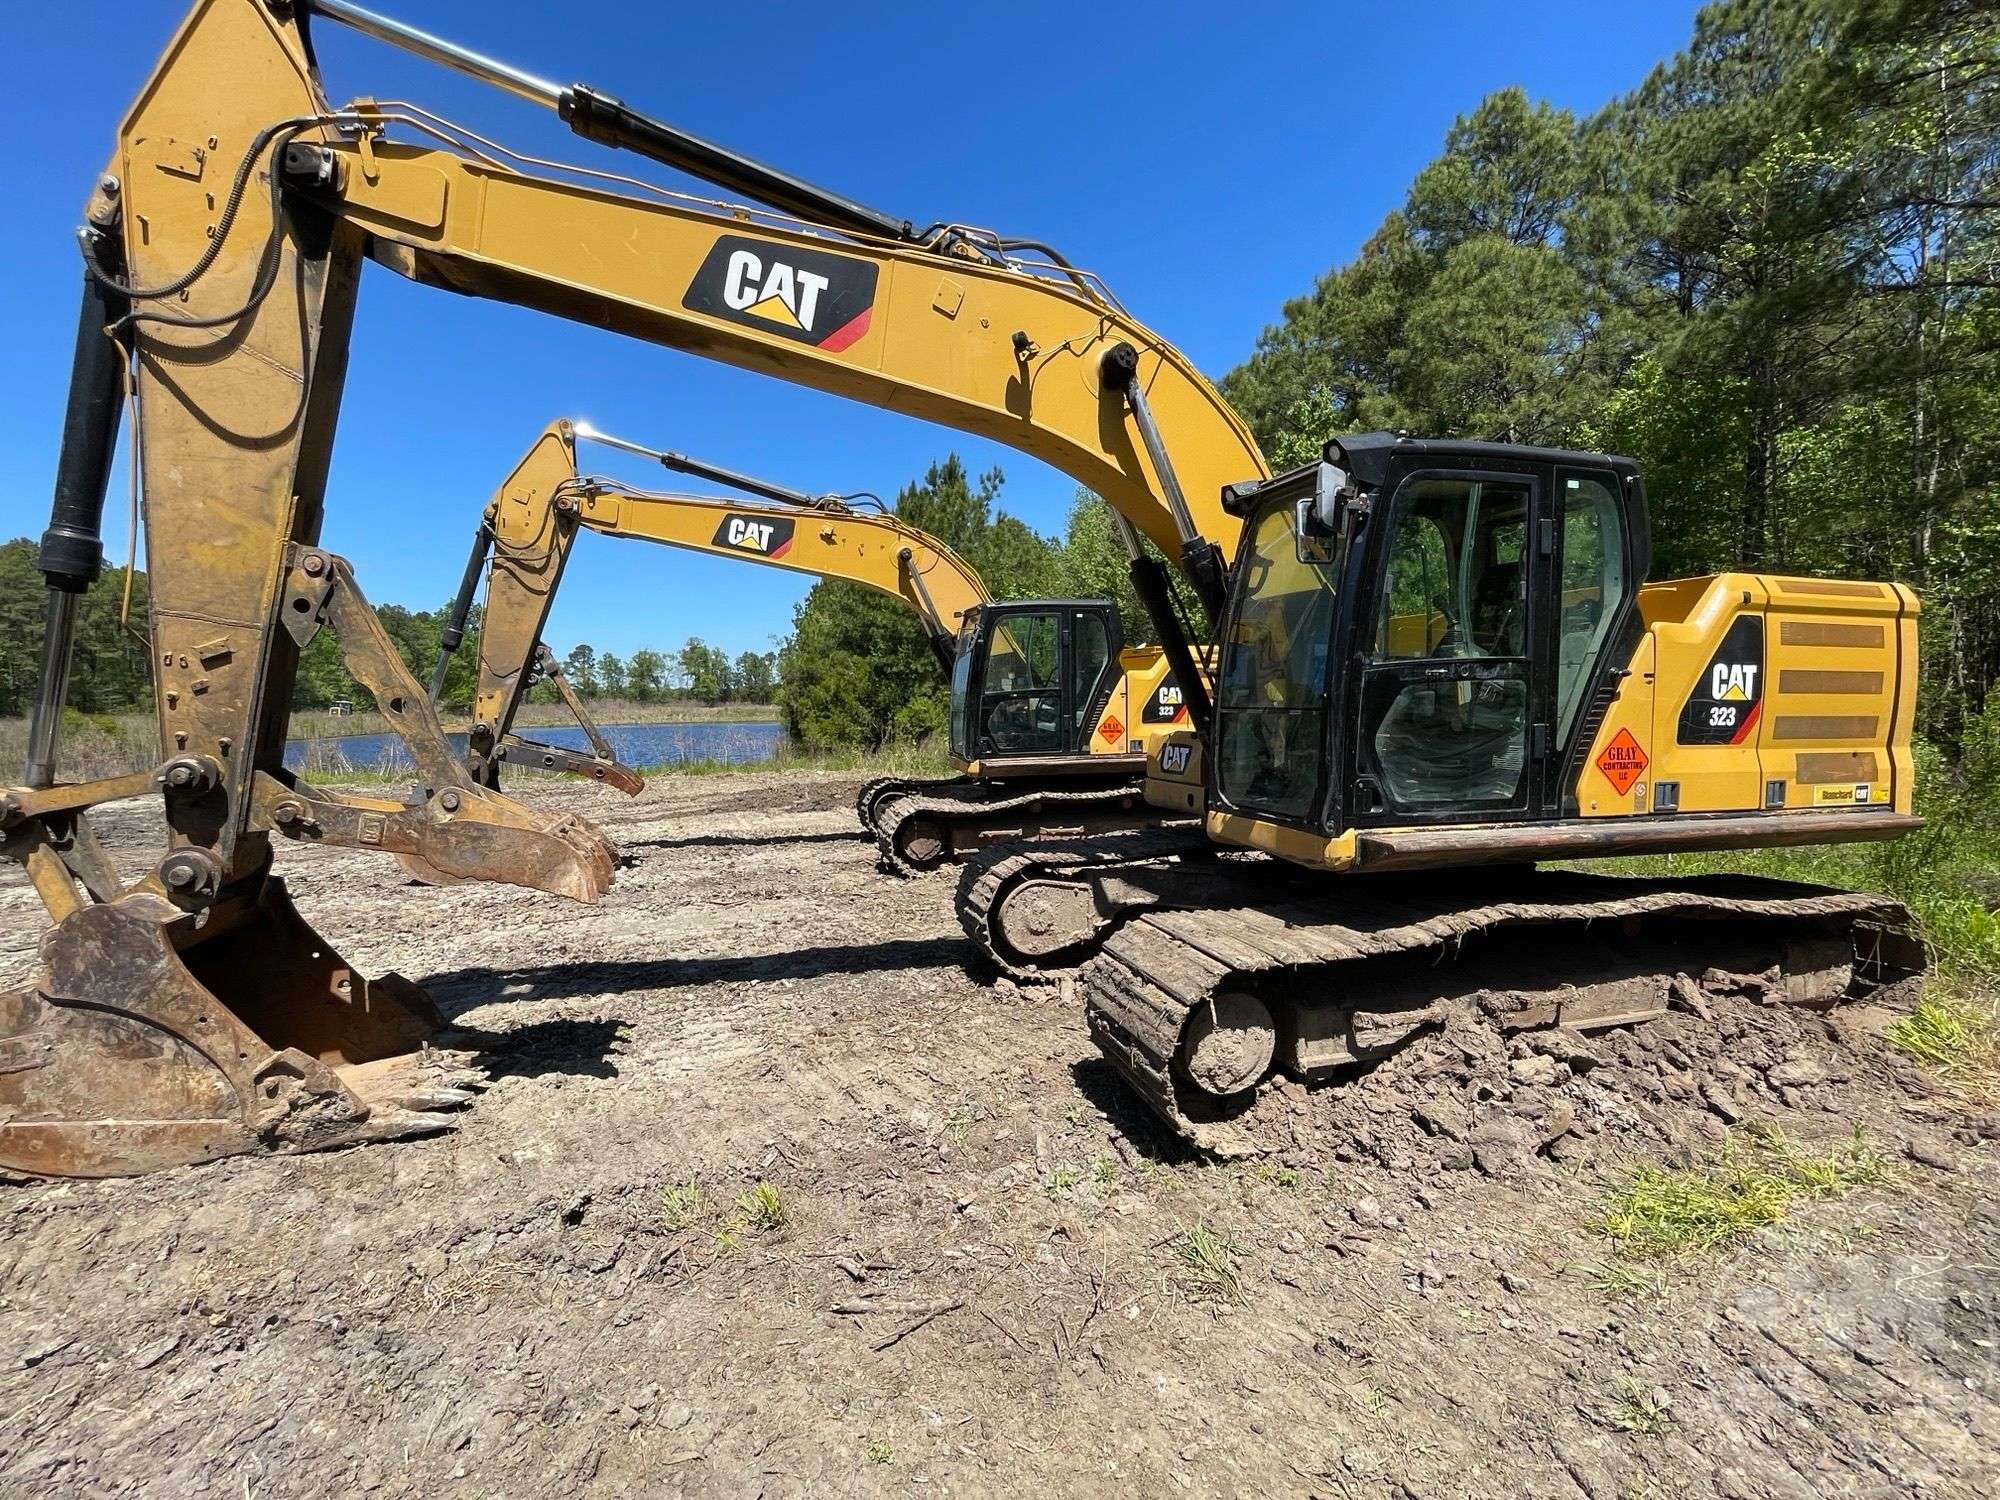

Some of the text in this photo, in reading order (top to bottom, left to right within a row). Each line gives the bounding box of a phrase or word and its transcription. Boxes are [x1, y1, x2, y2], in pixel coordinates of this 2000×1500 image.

[723, 250, 829, 332] CAT
[728, 518, 774, 551] CAT
[1712, 663, 1757, 700] CAT
[1159, 706, 1174, 716] 323
[1709, 706, 1736, 726] 323
[1163, 745, 1189, 771] CAT
[1608, 747, 1637, 760] GRAY
[1603, 761, 1642, 770] CONTRACTING
[1618, 772, 1629, 780] LLC
